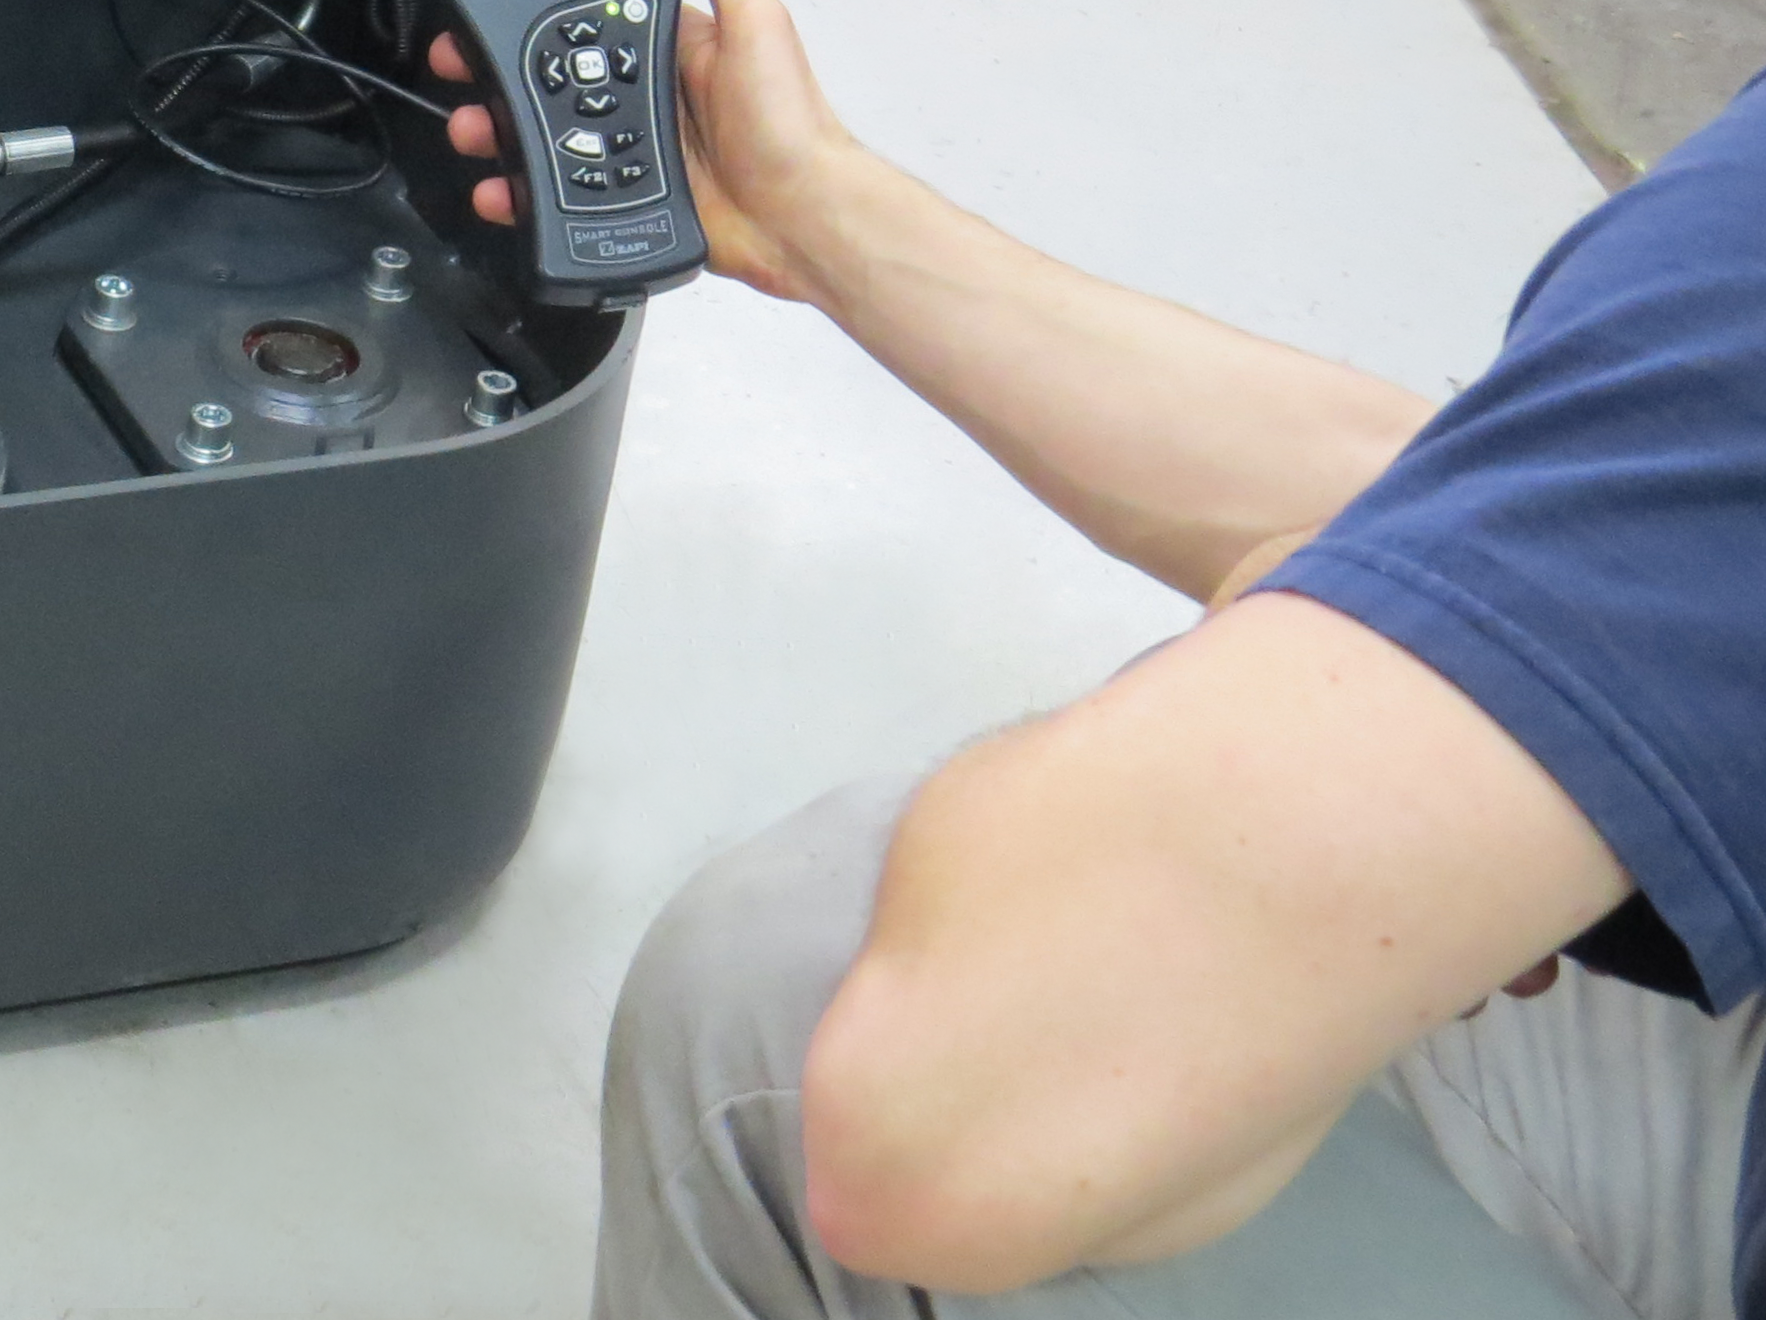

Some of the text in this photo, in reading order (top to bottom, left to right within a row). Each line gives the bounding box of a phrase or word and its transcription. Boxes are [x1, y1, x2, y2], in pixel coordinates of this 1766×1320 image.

[578, 59, 602, 70] OK
[616, 132, 633, 144] F1
[622, 166, 641, 177] F3
[574, 220, 668, 244] SMART CONSOLE
[615, 240, 649, 254] ZAPI
